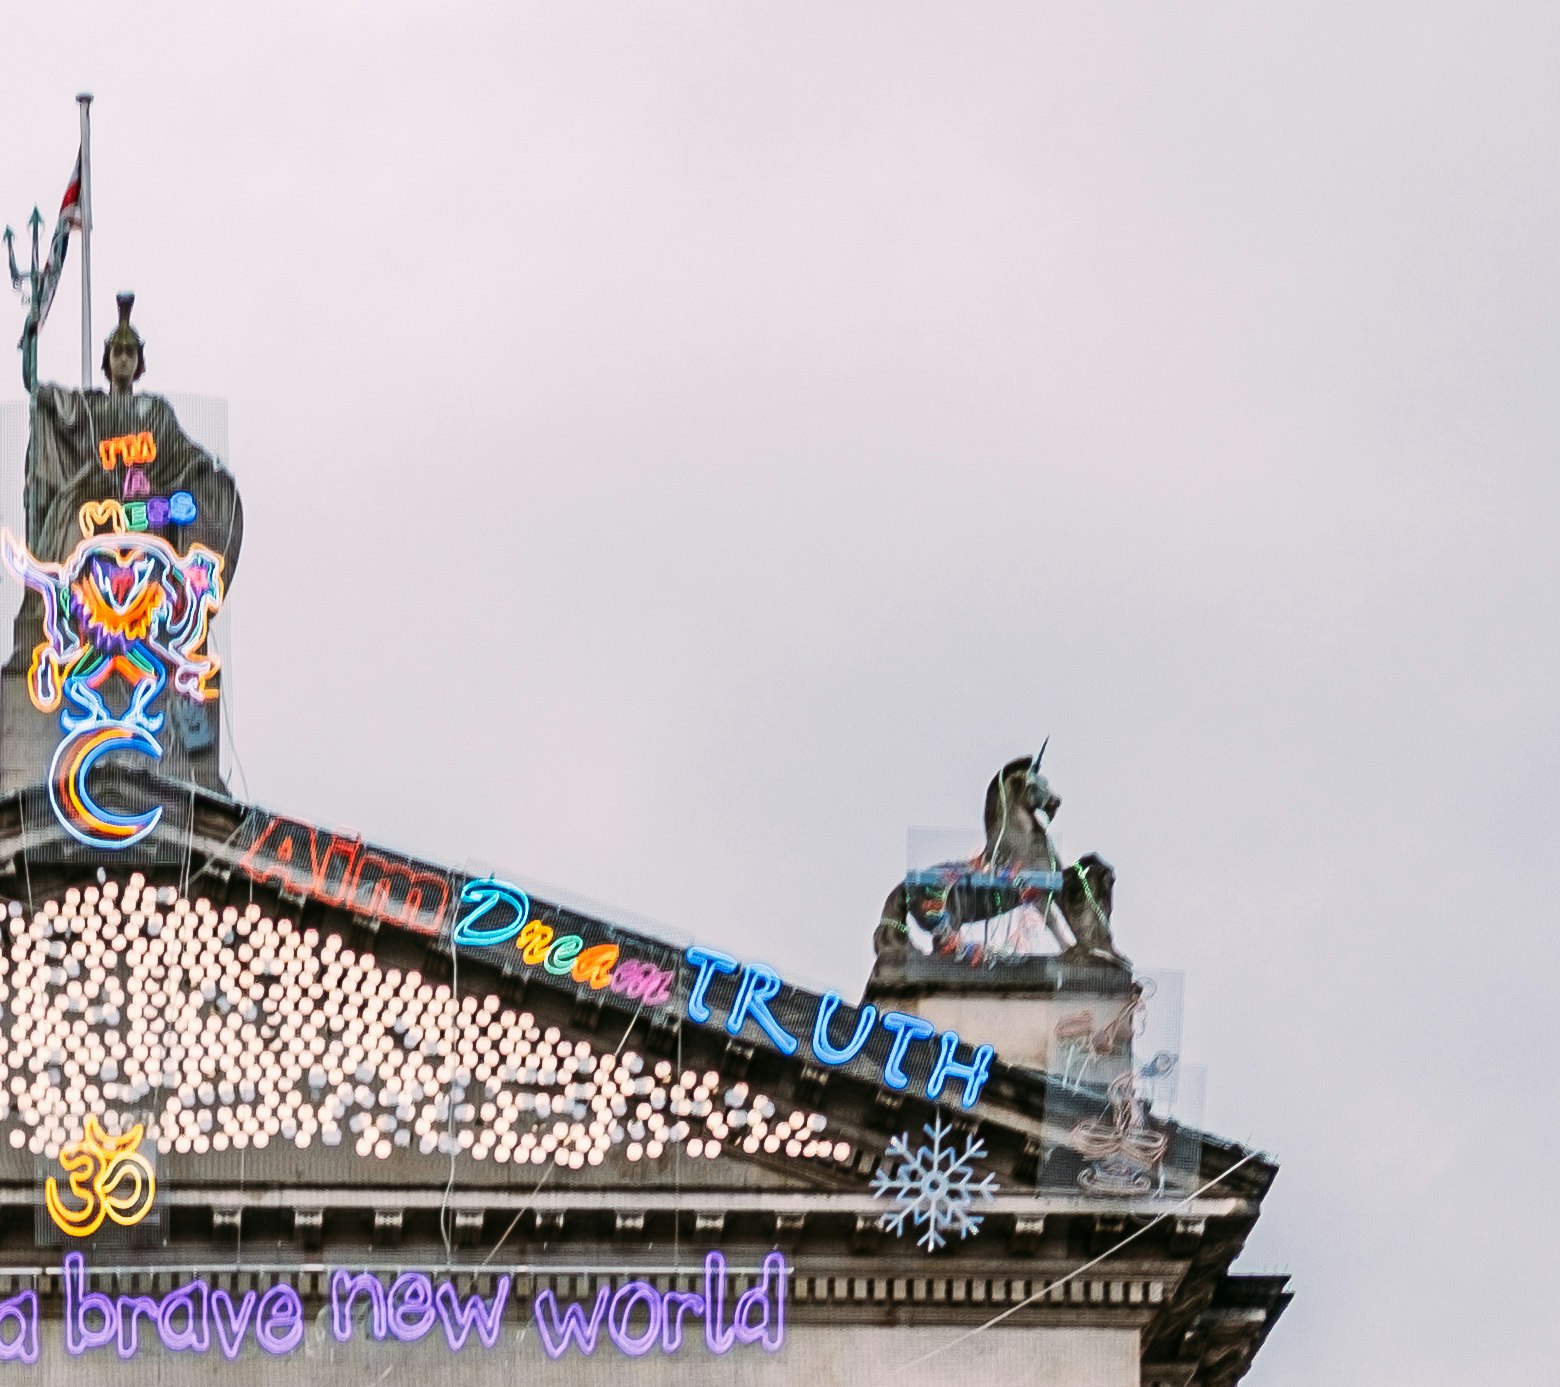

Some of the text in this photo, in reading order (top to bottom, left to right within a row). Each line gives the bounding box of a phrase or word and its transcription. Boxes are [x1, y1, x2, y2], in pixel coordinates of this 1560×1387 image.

[240, 815, 997, 1109] Aim Dream TRUTH
[63, 1252, 305, 1359] brave
[330, 1267, 512, 1351] new
[533, 1250, 786, 1359] world
